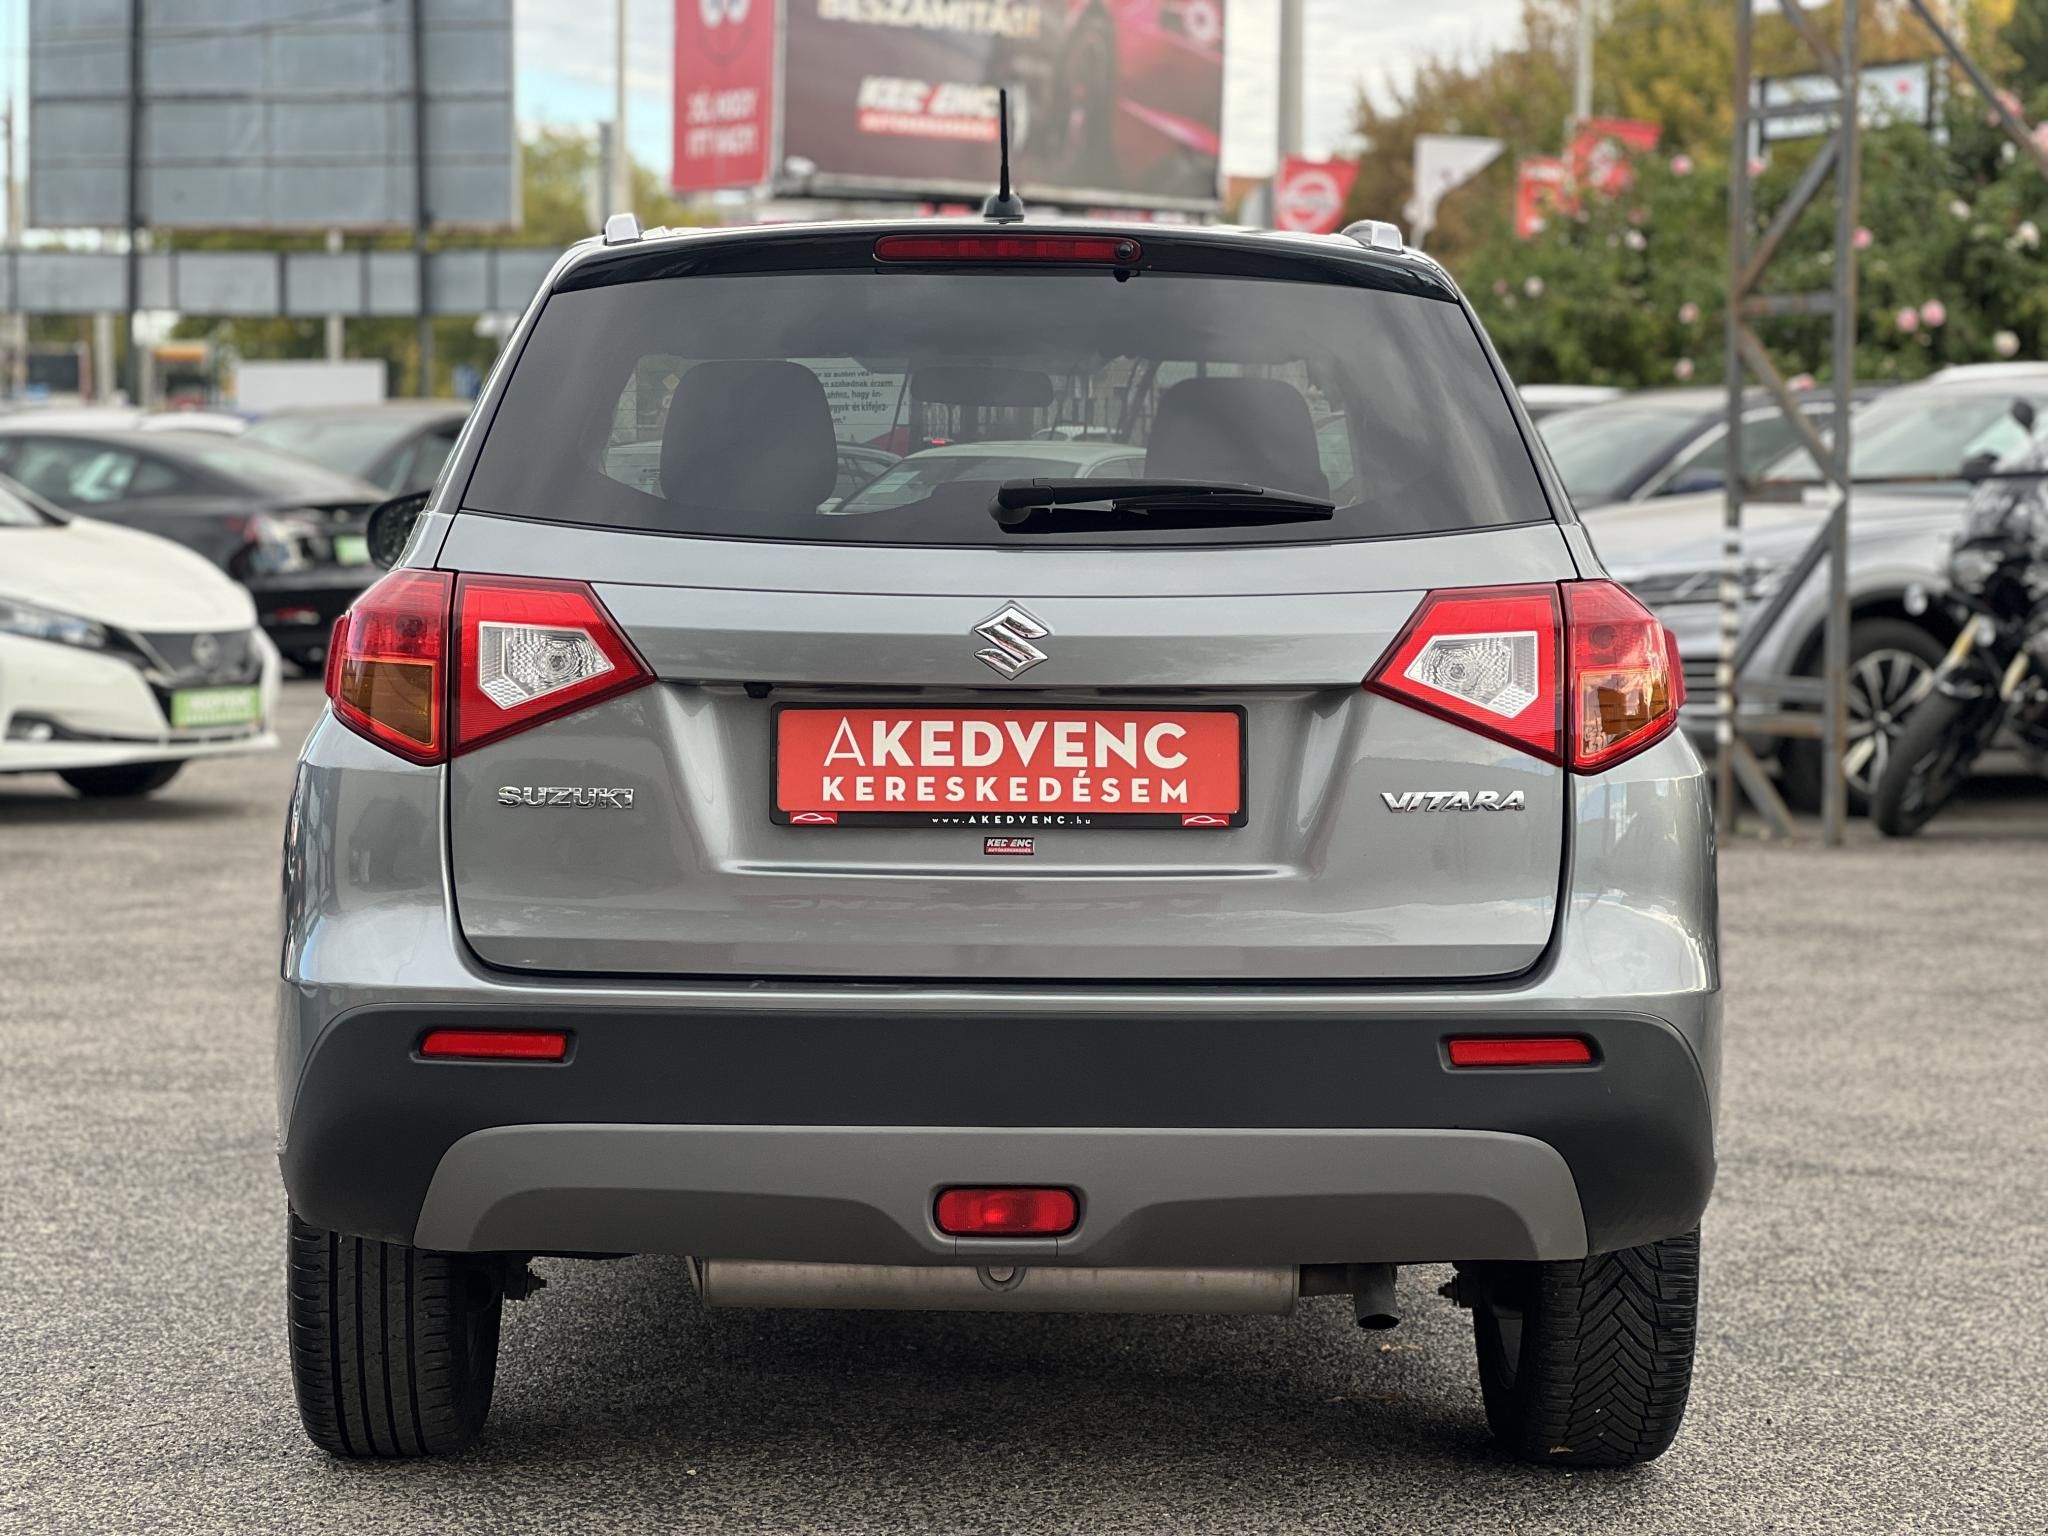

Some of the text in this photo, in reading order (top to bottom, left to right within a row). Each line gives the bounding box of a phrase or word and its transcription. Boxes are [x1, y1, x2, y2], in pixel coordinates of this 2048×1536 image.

[823, 717, 1188, 769] AKEDVENC
[497, 786, 634, 809] SUZUKI
[822, 770, 1188, 804] KERESKEDÉSEM
[1380, 790, 1526, 813] VITARA
